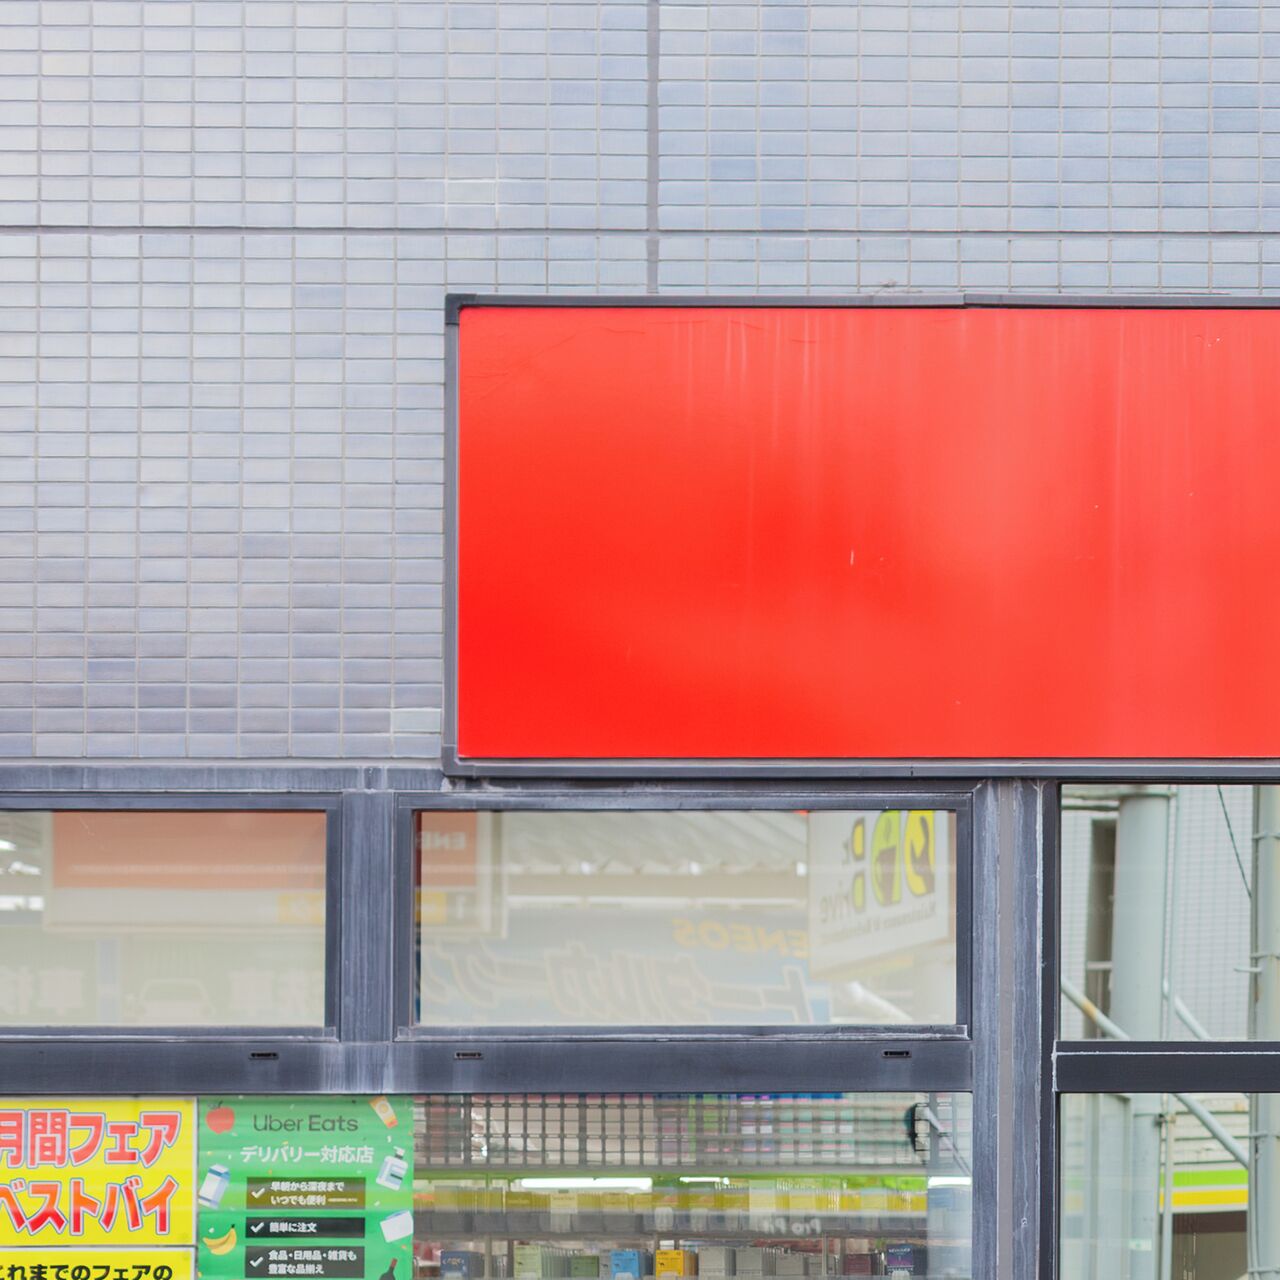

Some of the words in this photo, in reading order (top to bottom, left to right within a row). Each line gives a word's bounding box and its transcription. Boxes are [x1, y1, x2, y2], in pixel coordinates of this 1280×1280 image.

[253, 1114, 304, 1132] Uber
[308, 1114, 358, 1132] Eats
[240, 1145, 375, 1163] デリバリー対応店
[269, 1222, 318, 1233] 簡単に注文
